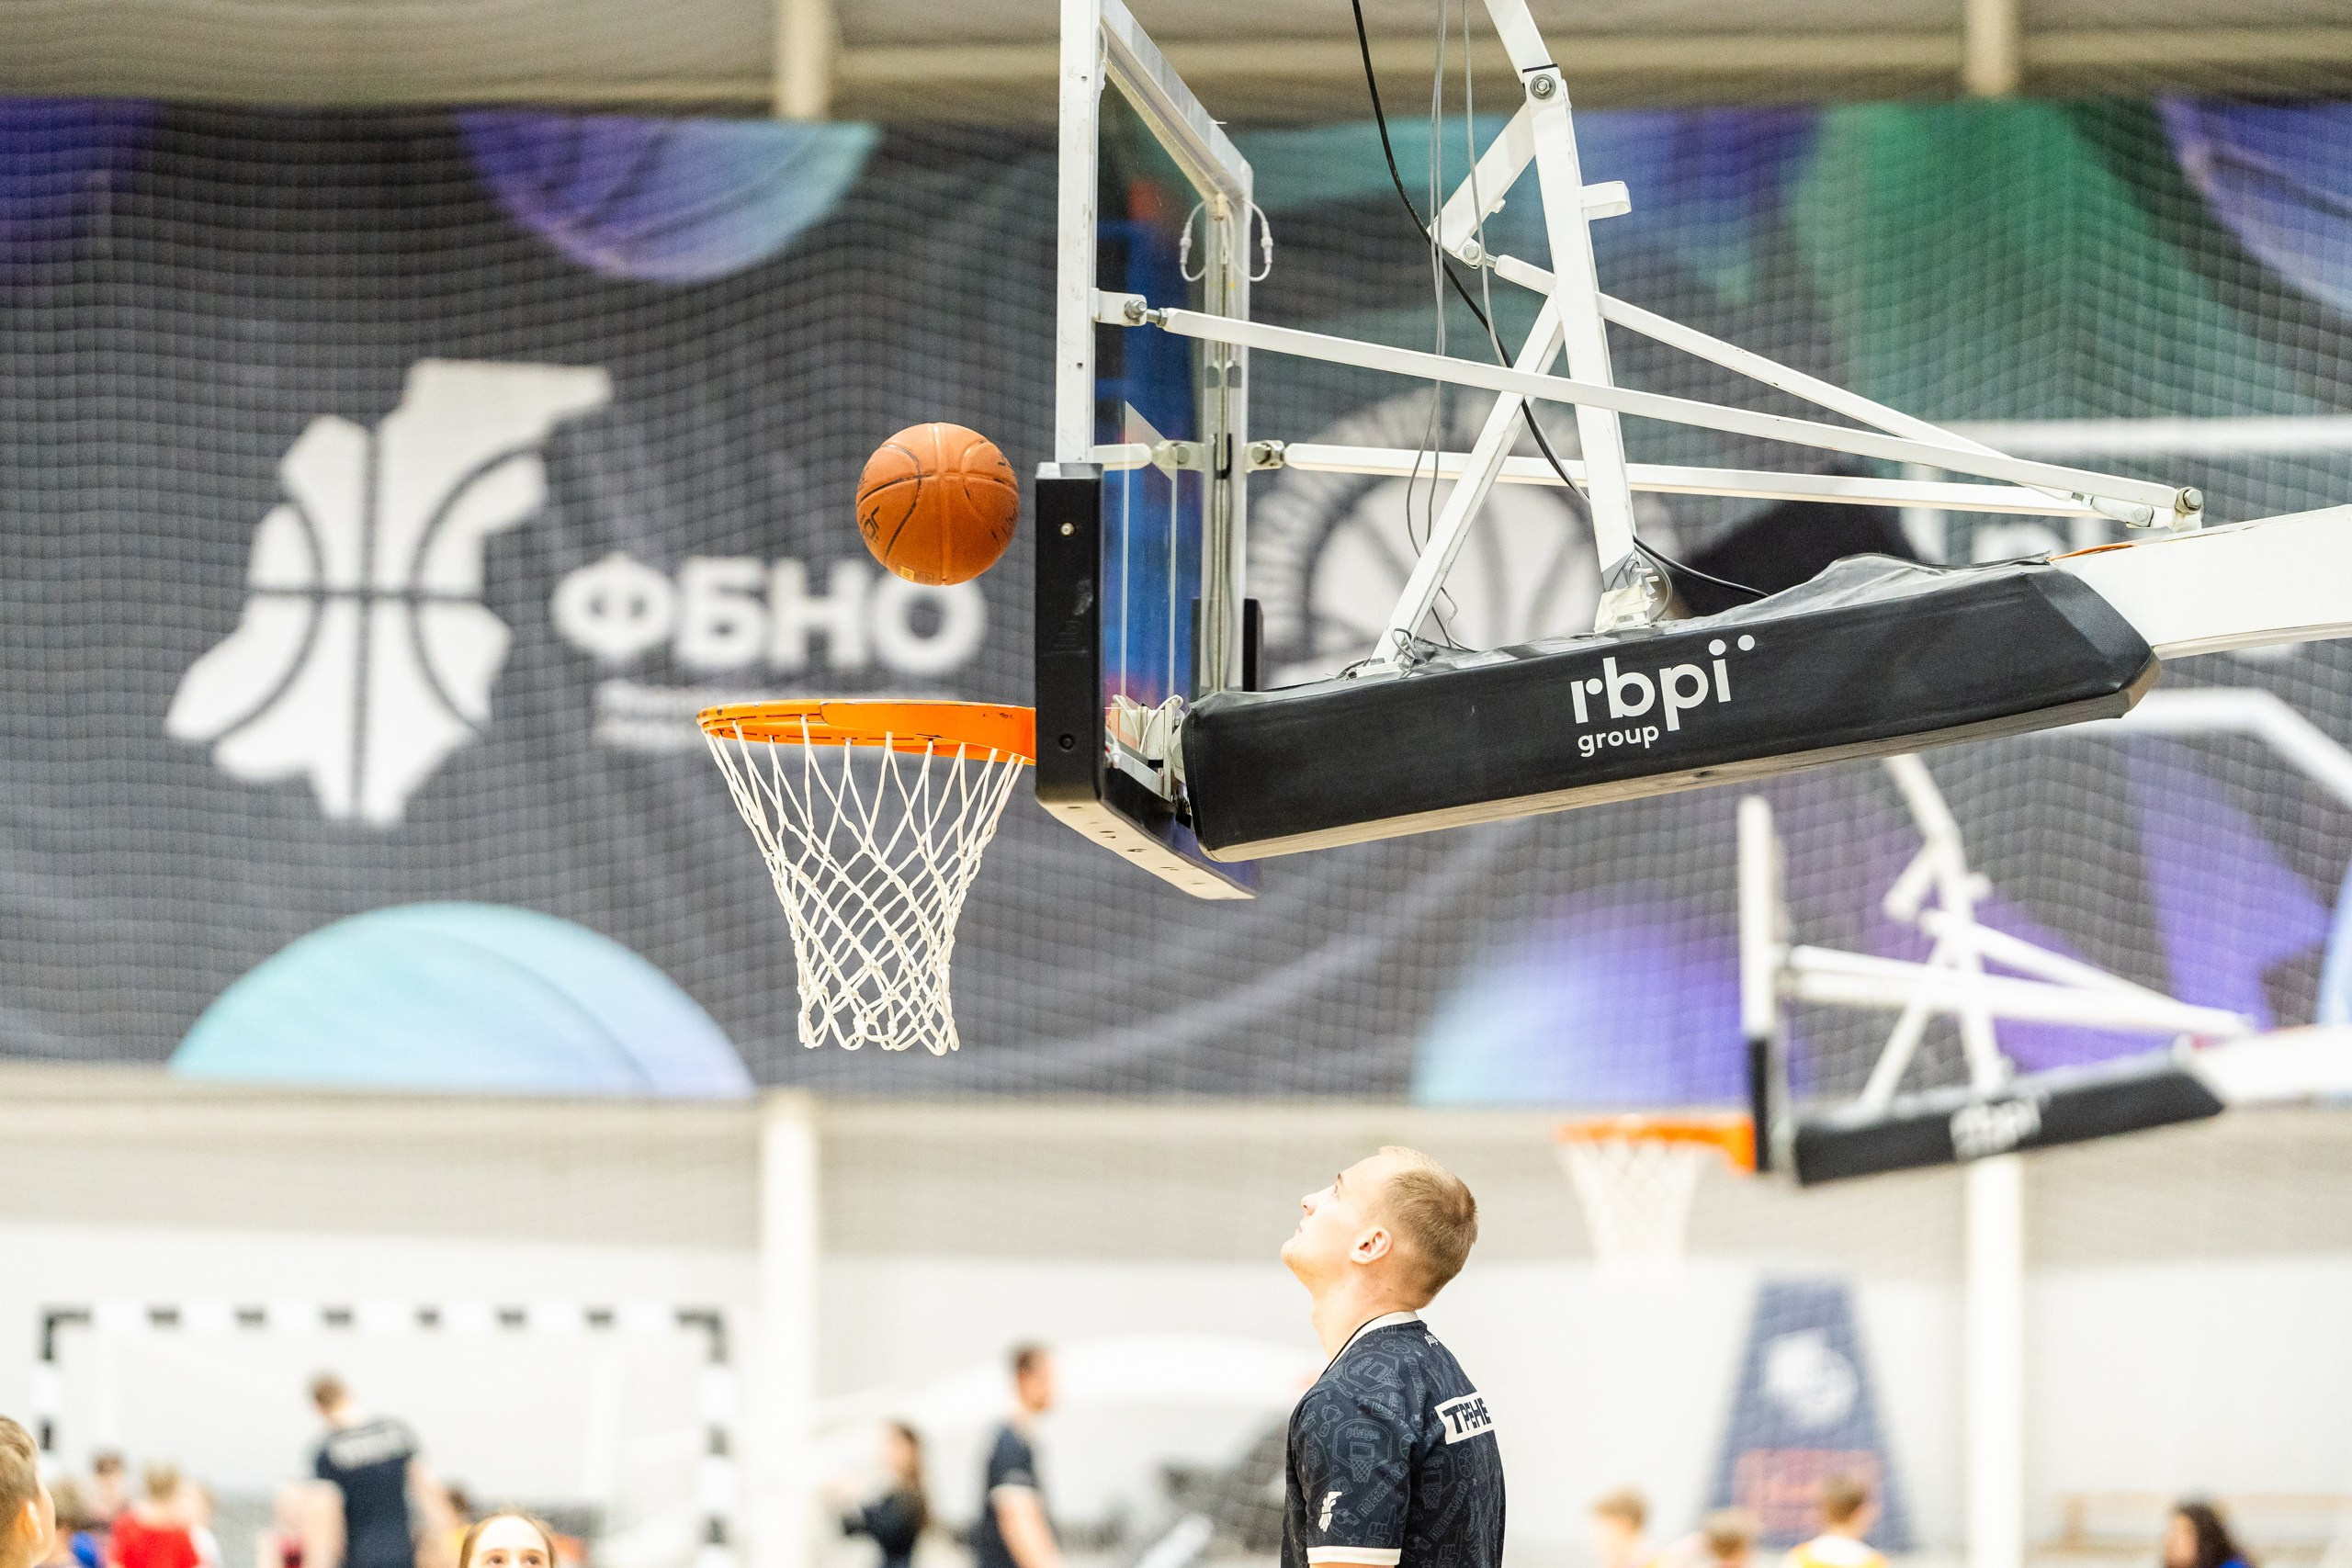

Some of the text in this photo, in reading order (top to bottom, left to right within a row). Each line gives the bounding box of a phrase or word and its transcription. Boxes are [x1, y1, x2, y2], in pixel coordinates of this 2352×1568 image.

[552, 552, 987, 674] ФБНО
[1577, 726, 1660, 758] group
[1441, 1397, 1492, 1435] ТРЕНЕ
